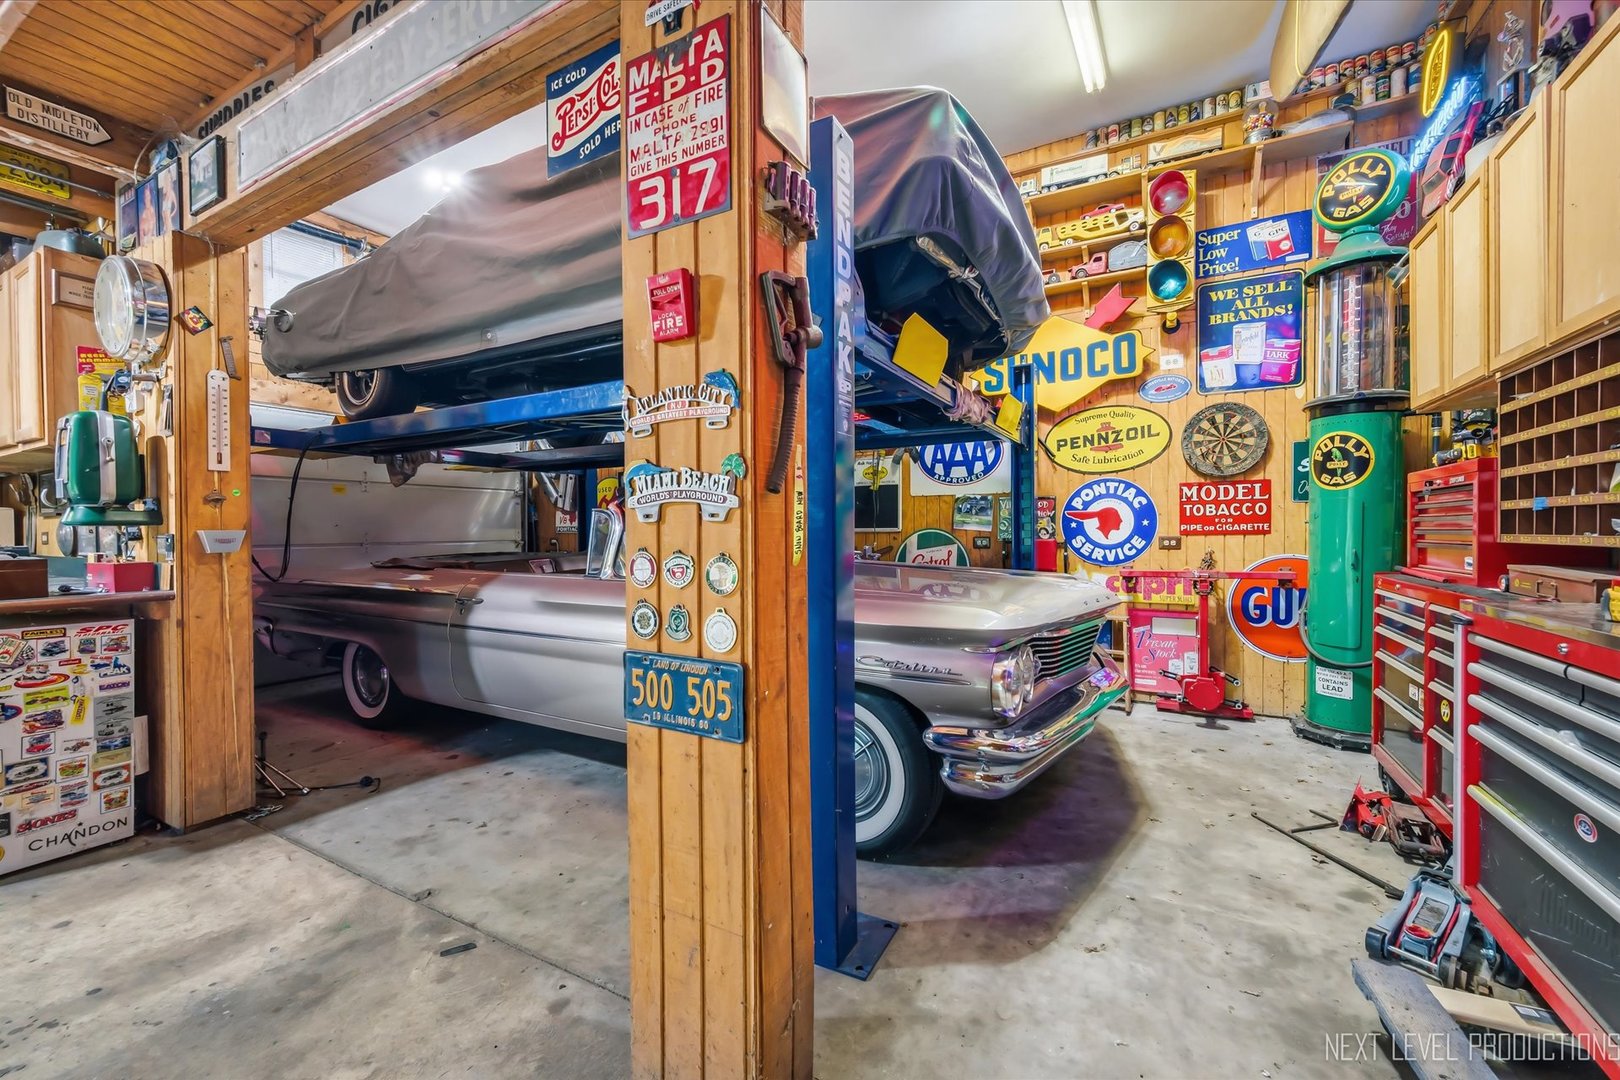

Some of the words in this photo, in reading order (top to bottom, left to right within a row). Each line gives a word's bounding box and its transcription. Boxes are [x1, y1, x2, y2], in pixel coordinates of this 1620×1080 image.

[646, 8, 662, 21] DRIVE
[628, 28, 724, 93] MALTA
[551, 77, 564, 92] ICE
[565, 67, 587, 84] COLD
[8, 92, 32, 108] OLD
[41, 104, 100, 133] MIDLETON
[630, 117, 641, 134] IN
[644, 106, 674, 128] CASE
[678, 97, 689, 114] of
[695, 84, 724, 108] FIRE
[17, 108, 89, 140] DISTILLERY
[653, 114, 697, 137] PHONE
[579, 135, 601, 159] SOLD
[604, 120, 620, 138] HER
[630, 132, 682, 163] MALTA
[630, 161, 652, 177] GIVE
[656, 151, 678, 169] THIS
[681, 134, 725, 158] NUMBER
[1322, 158, 1387, 198] POLLY
[638, 157, 718, 230] 317
[1332, 195, 1375, 217] GAS
[1198, 228, 1241, 247] Super
[1268, 226, 1287, 236] GPC
[1199, 247, 1228, 262] Low
[1199, 257, 1240, 277] Price!
[653, 287, 666, 296] PULL
[667, 284, 680, 293] DOWN
[1209, 289, 1239, 302] WE
[1243, 280, 1292, 296] SELL
[1231, 296, 1269, 310] ALL
[653, 315, 683, 332] FIRE
[1208, 304, 1294, 325] BRANDS!
[660, 328, 679, 336] ALARM
[1267, 351, 1290, 359] LARK
[636, 384, 695, 417] ATLANTIC
[698, 383, 731, 406] CITY
[688, 406, 728, 416] PLAYGROUND
[1074, 410, 1109, 425] Supreme
[1109, 409, 1136, 420] Quality
[1056, 424, 1161, 452] PENNZOIL
[1315, 435, 1370, 461] POLLY
[931, 441, 990, 477] AAA
[1071, 453, 1091, 465] Safe
[1092, 448, 1145, 465] Lubrication
[634, 471, 679, 495] MIAMI
[680, 467, 731, 494] BEACH
[933, 471, 985, 484] APPROVED
[1320, 471, 1357, 485] GAS
[639, 492, 670, 504] WORLD'S
[673, 491, 724, 503] PLAYGROUND
[1071, 481, 1148, 510] PONTIAC
[1181, 483, 1269, 502] MODEL
[1183, 502, 1267, 517] TOBACCO
[1216, 523, 1270, 531] CIGARETTE
[1071, 535, 1147, 563] SERVICE
[652, 660, 669, 670] LAND
[670, 662, 678, 670] OF
[680, 664, 708, 675] LINCOLN
[856, 655, 963, 676] Catalina
[1318, 677, 1349, 687] CONTAINS
[1322, 684, 1344, 692] LEAD
[632, 668, 673, 711] 500
[687, 676, 732, 721] 505
[664, 713, 696, 727] ILLINOIS
[28, 817, 128, 851] CHANDON
